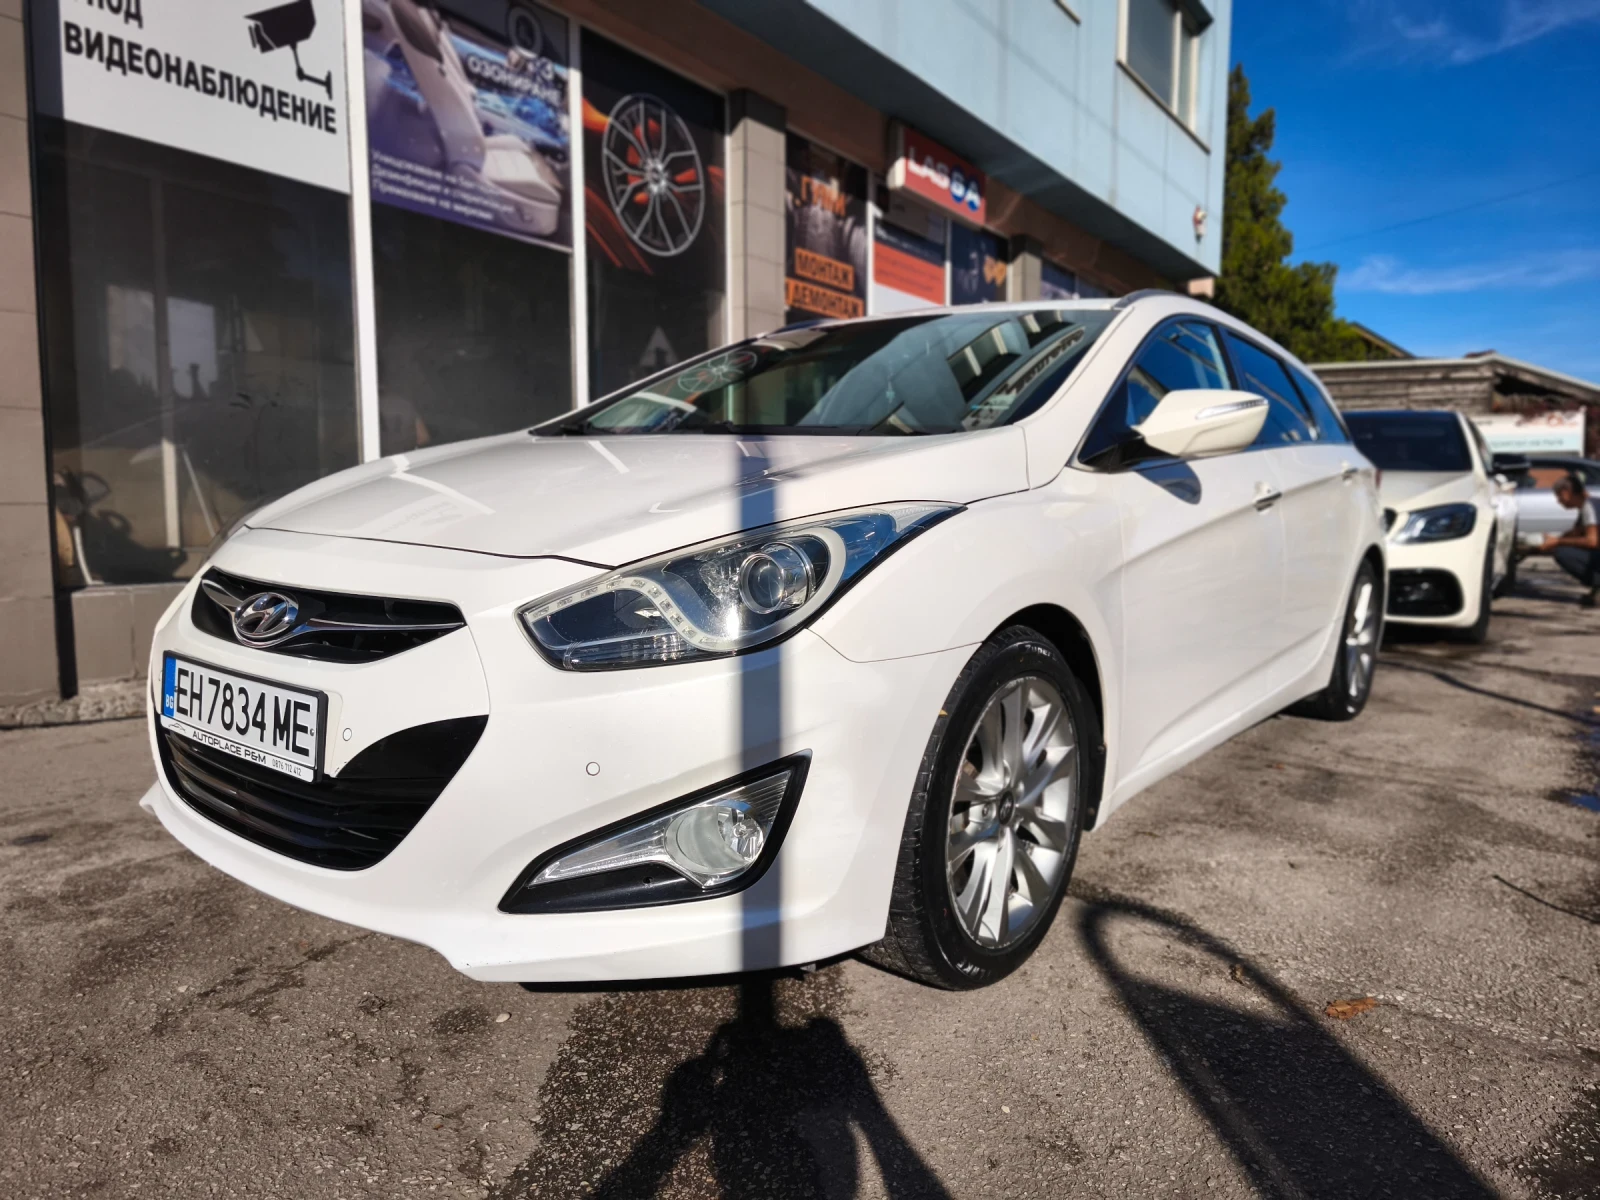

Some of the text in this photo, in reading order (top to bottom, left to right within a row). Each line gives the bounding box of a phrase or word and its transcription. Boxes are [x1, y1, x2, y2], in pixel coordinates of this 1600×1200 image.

[63, 20, 337, 134] ВИДЕОНАБЛЮДЕНИЕ
[165, 693, 174, 709] BG
[176, 667, 311, 757] EH 7834 ME
[192, 731, 267, 764] AUTOPLACE P&M
